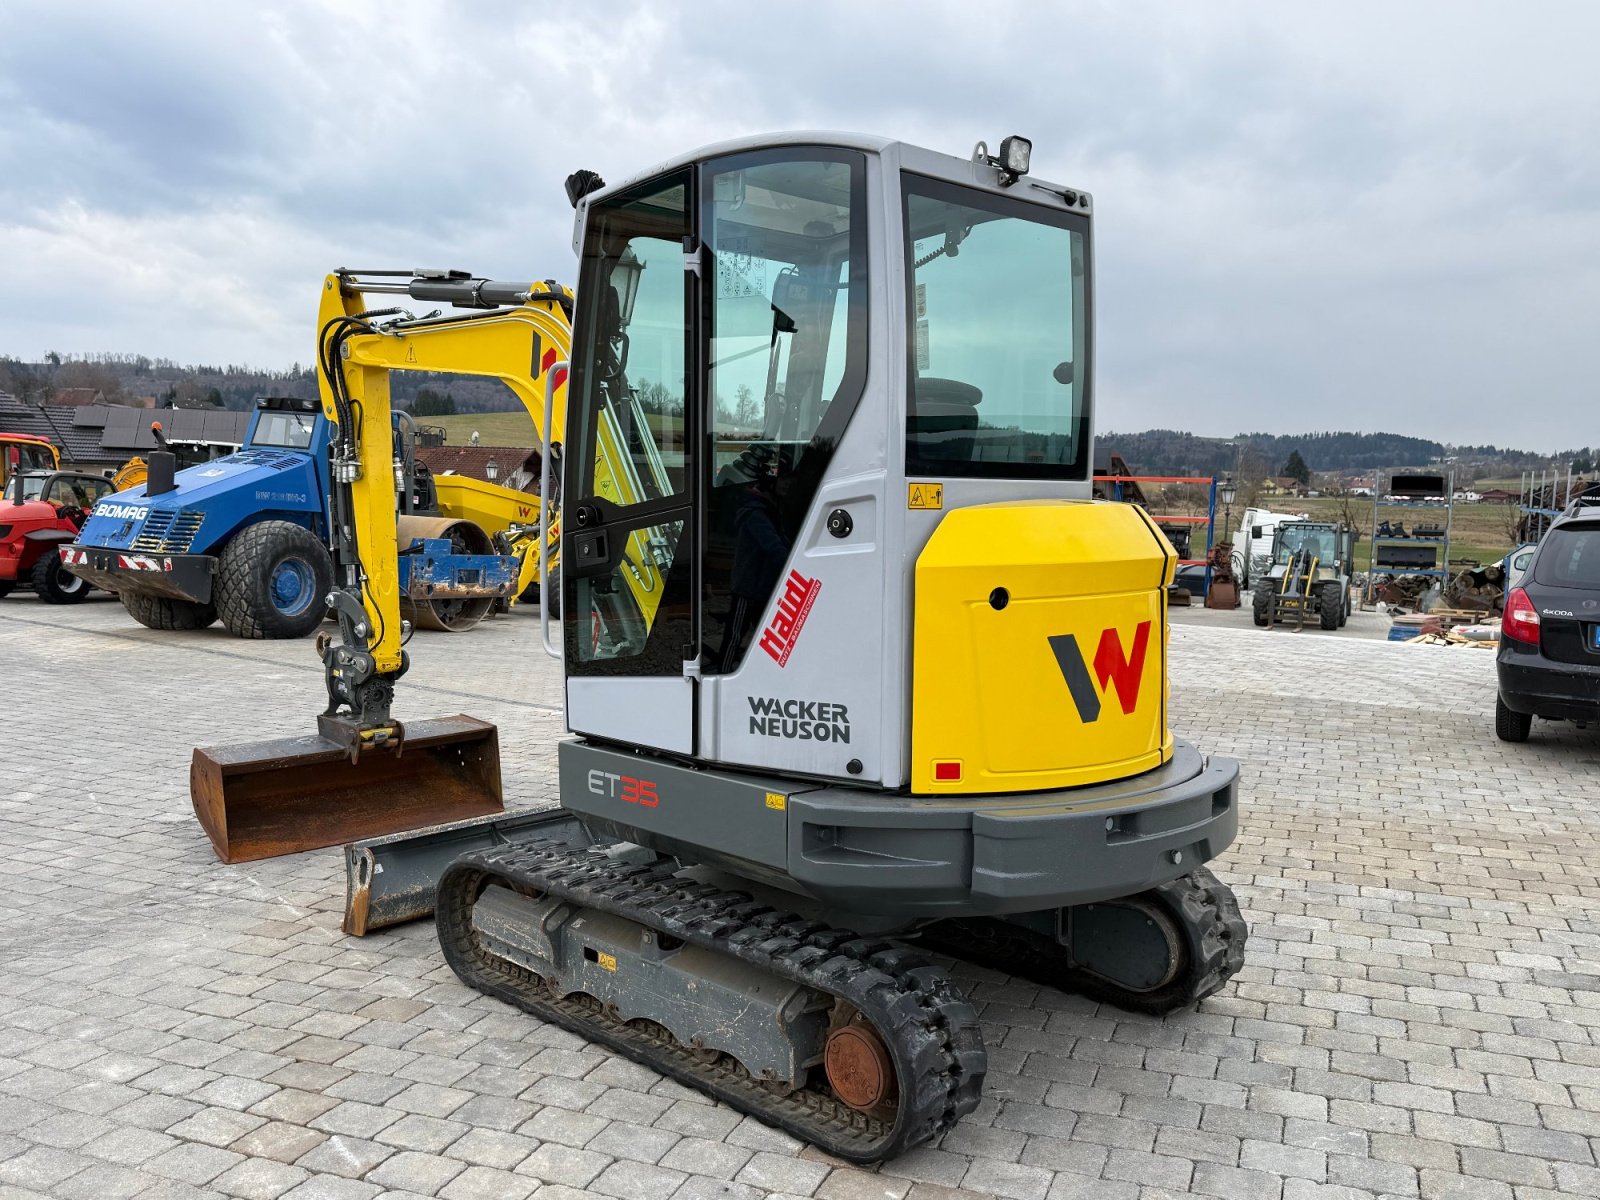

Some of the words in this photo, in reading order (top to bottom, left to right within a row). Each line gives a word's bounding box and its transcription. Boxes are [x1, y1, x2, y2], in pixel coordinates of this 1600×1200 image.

[95, 503, 149, 520] BOMAG
[780, 644, 792, 666] NUTZ
[791, 581, 821, 641] BAUMASCHINEN
[747, 696, 850, 724] WACKER
[749, 716, 851, 744] NEUSON
[587, 768, 660, 808] ET35
